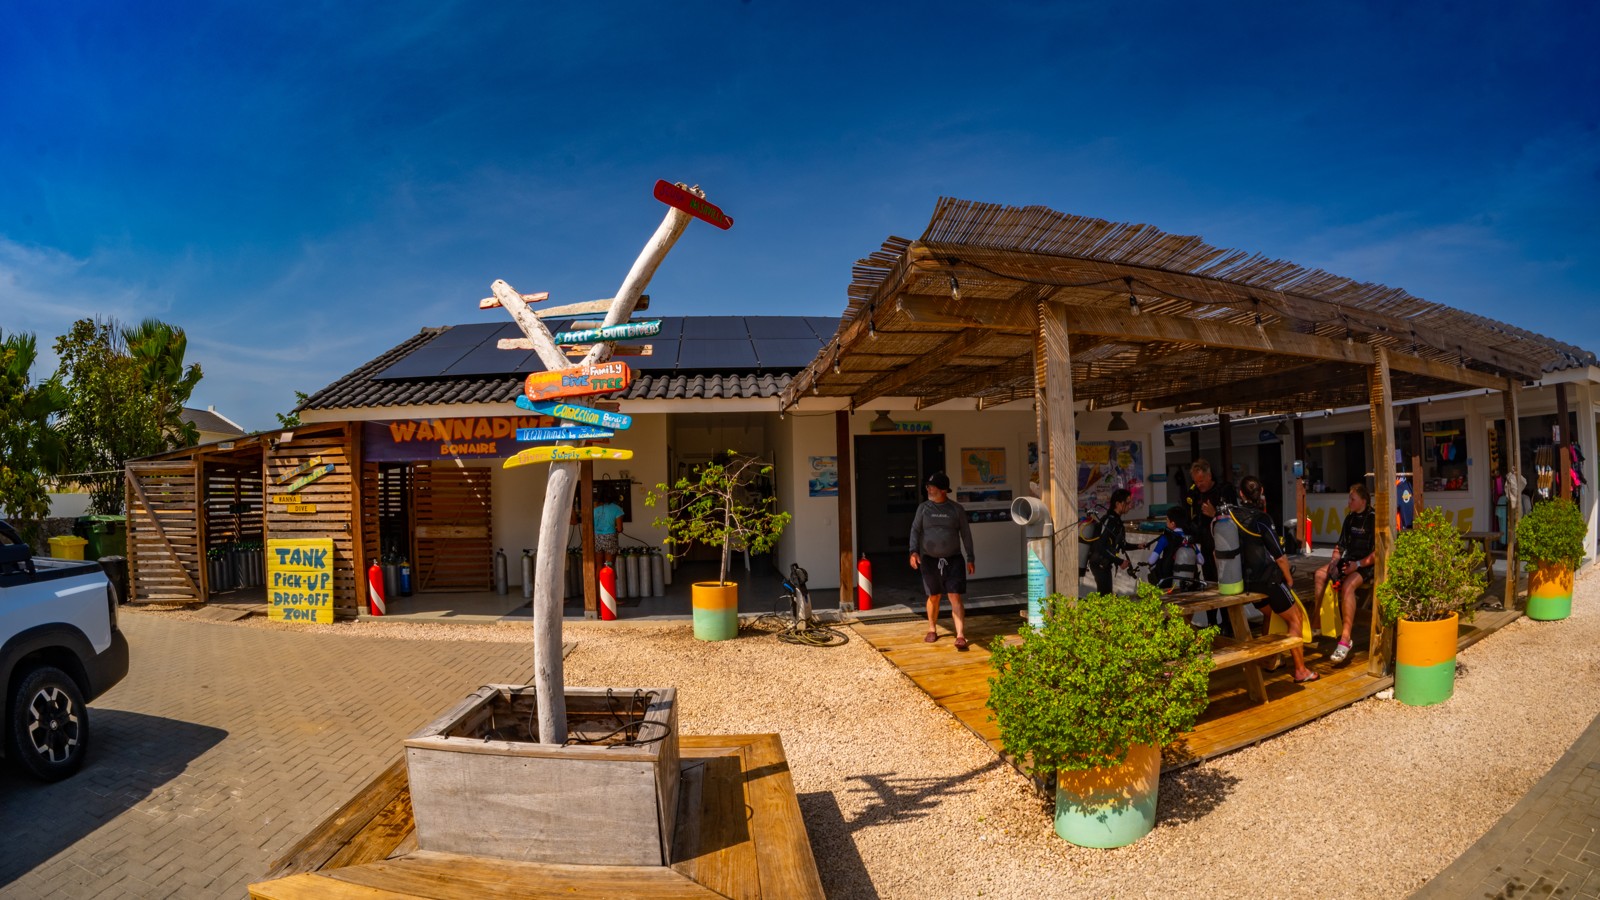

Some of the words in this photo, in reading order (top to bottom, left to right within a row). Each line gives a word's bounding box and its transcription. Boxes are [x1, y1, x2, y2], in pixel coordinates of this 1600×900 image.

[563, 330, 593, 342] DEEP
[591, 378, 623, 390] TREE
[389, 416, 555, 443] WANNADIVE
[440, 442, 497, 456] BONAIRE
[275, 548, 328, 569] TANK
[273, 592, 329, 606] DROP-OFF
[283, 608, 317, 622] ZONE
